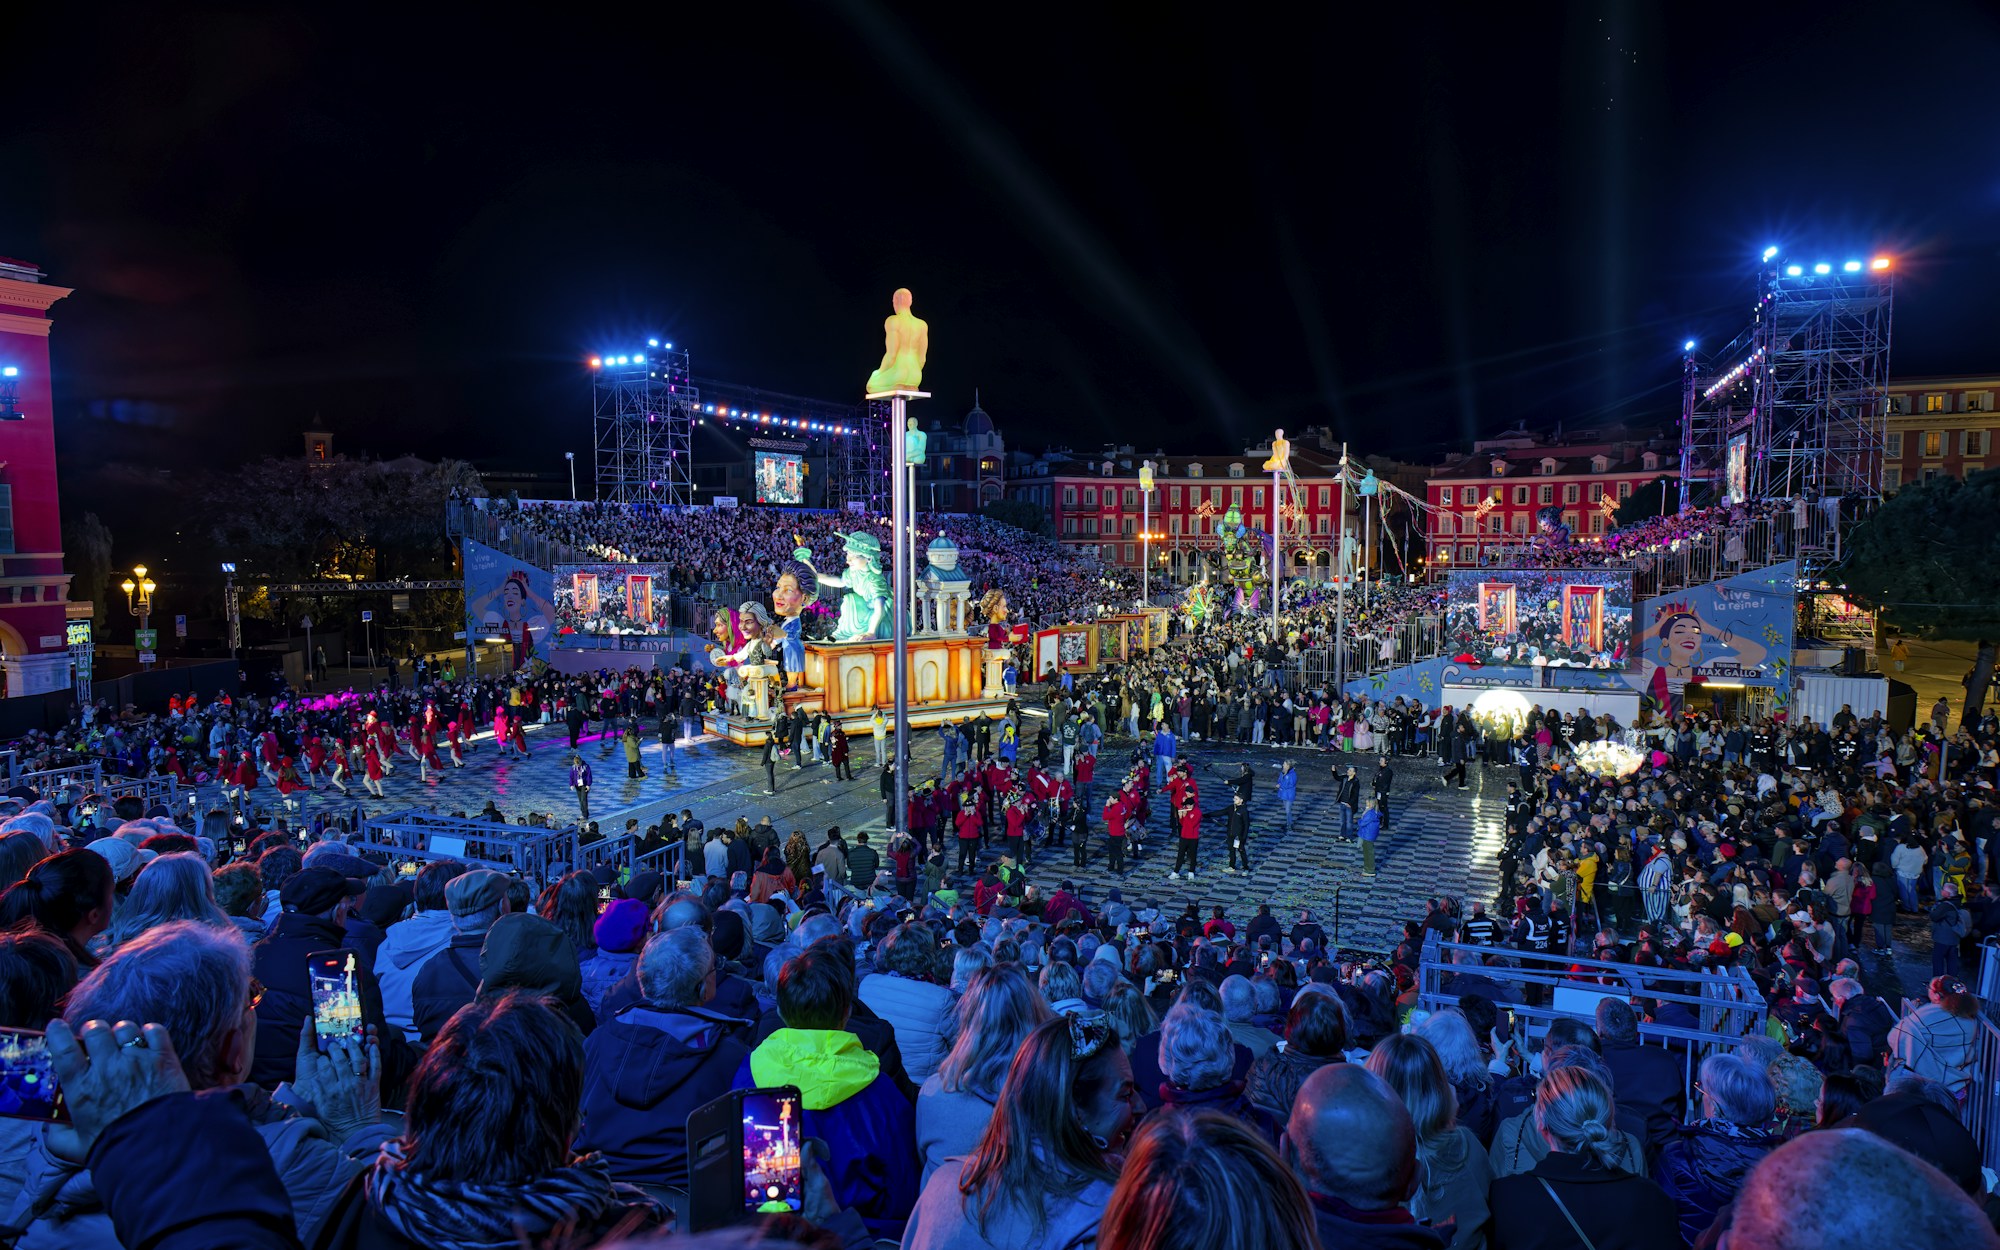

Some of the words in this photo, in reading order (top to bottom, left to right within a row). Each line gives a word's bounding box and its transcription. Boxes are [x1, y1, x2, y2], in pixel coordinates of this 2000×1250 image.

[1713, 601, 1726, 611] la
[1697, 668, 1722, 676] MAX
[1724, 669, 1757, 678] GALLO
